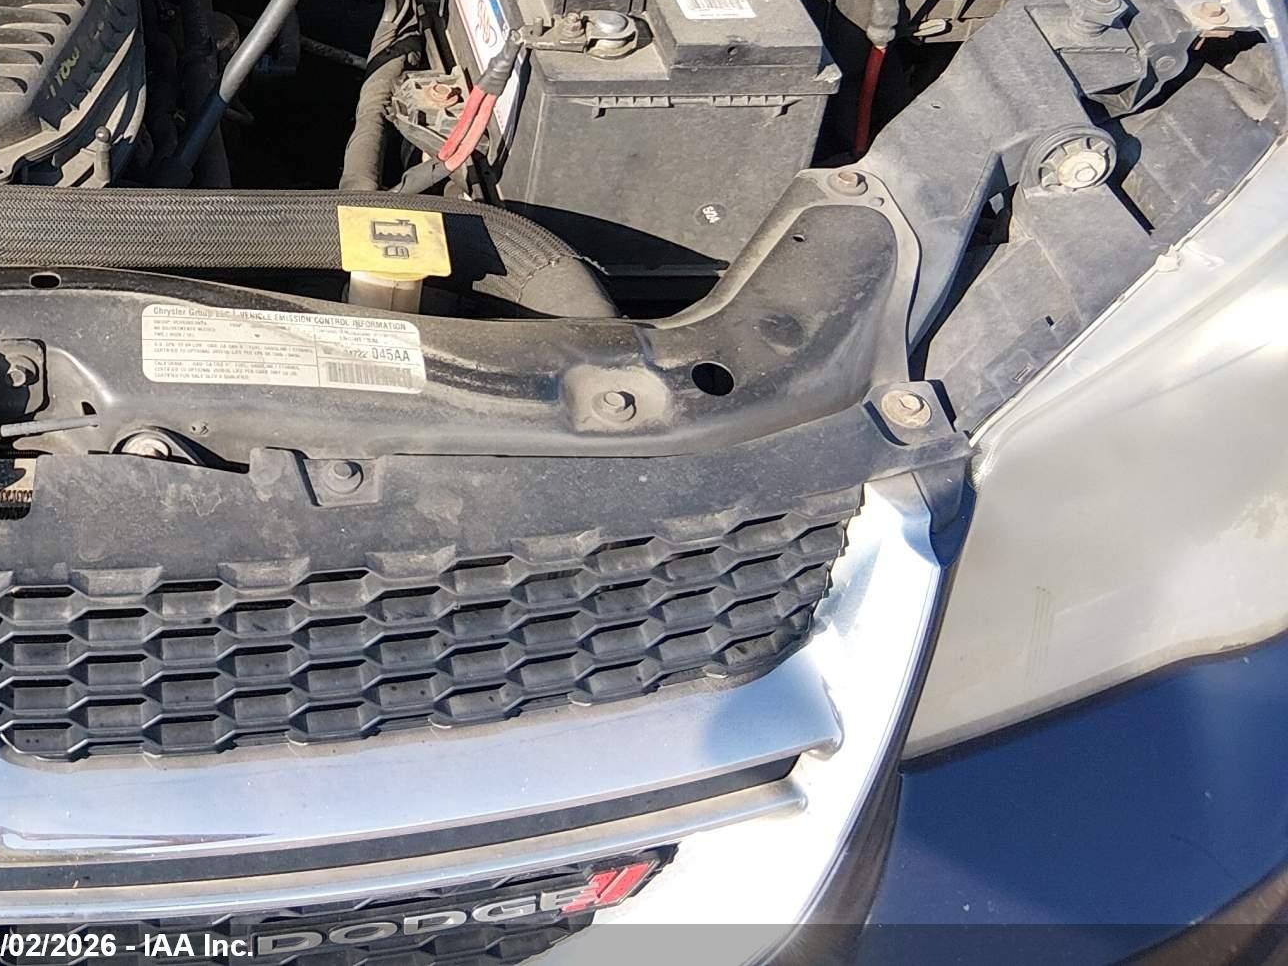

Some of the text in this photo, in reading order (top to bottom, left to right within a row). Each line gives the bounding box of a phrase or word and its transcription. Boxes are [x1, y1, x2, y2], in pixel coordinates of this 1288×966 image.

[153, 306, 187, 317] Chrysler
[239, 311, 272, 321] VEHICLE
[274, 313, 312, 323] EMISSION
[313, 316, 350, 327] CONTROL
[352, 318, 407, 331] INFORMATION
[256, 889, 588, 955] DODGE
